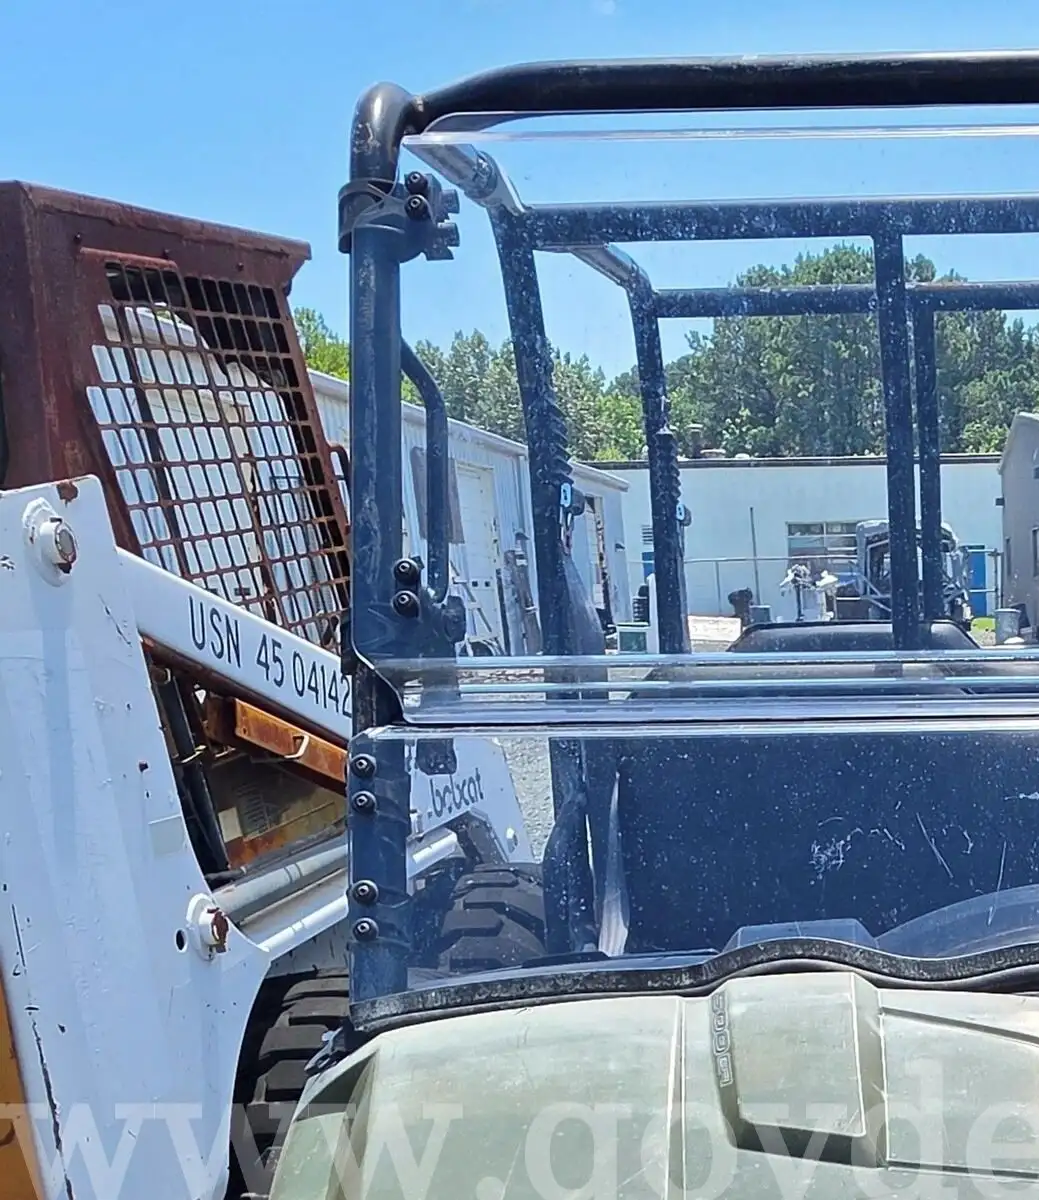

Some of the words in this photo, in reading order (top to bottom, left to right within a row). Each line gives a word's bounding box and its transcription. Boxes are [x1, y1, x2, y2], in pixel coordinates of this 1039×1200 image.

[188, 596, 242, 669] USN
[256, 633, 285, 688] 45
[292, 651, 352, 718] 04142
